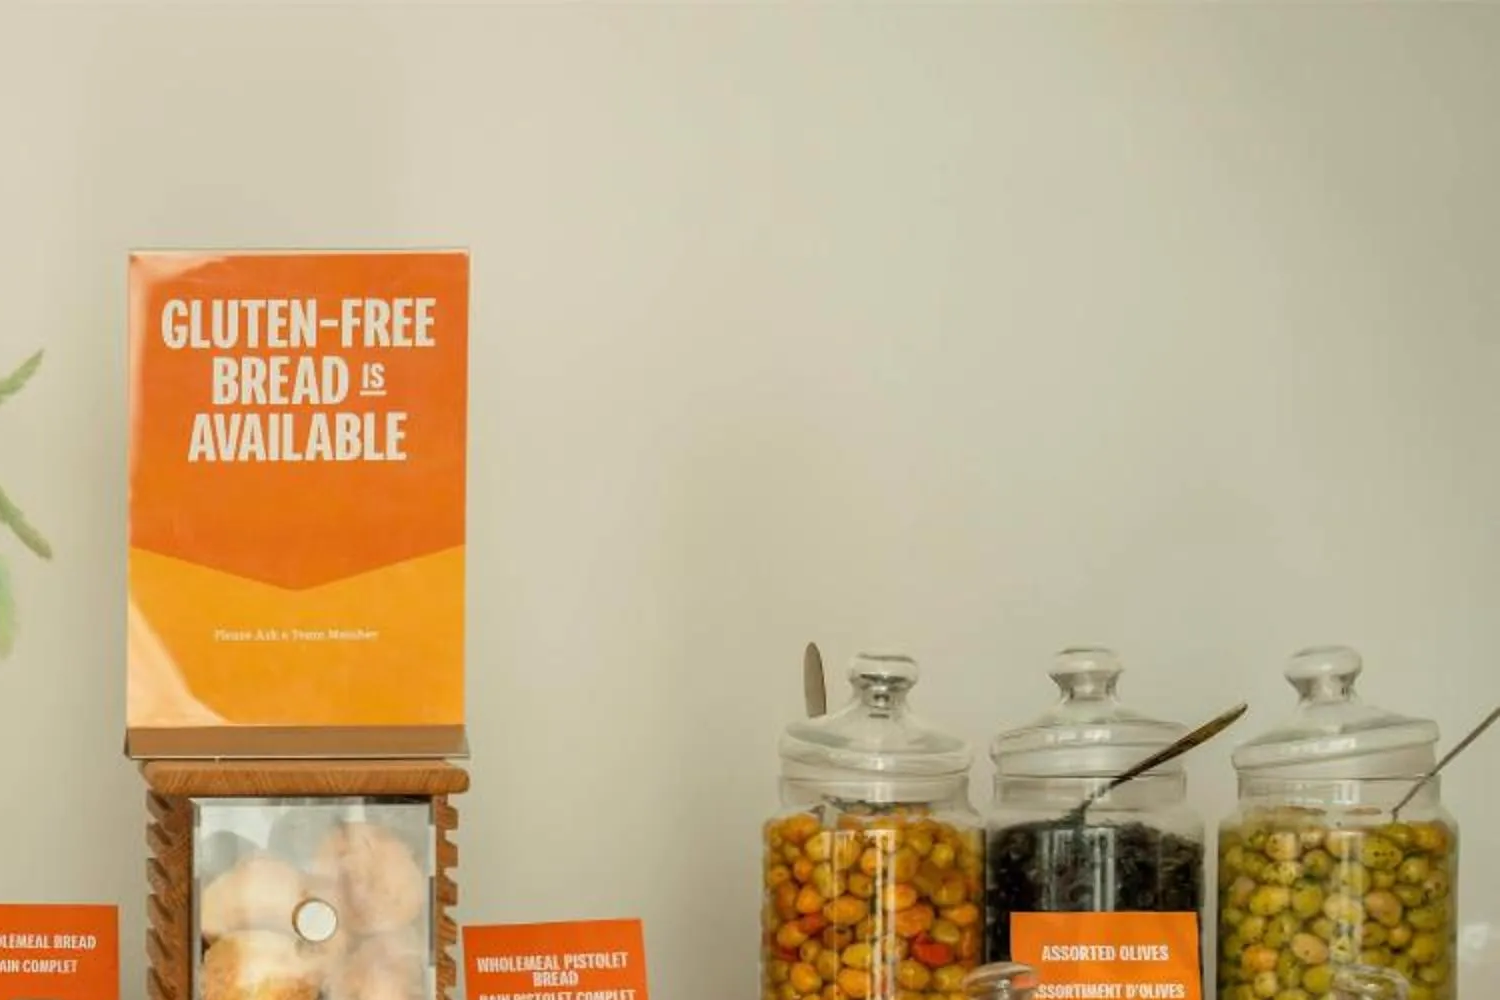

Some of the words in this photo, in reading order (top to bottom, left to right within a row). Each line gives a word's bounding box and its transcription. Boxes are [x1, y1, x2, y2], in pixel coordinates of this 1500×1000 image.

[161, 297, 437, 349] GLUTEN-FREE
[212, 355, 349, 405] BREAD
[361, 363, 386, 389] IS
[188, 412, 408, 462] AVAILABLE
[213, 628, 251, 641] Please
[255, 629, 277, 641] Ask
[292, 629, 325, 641] Team
[328, 628, 378, 640] Member
[53, 934, 97, 950] BREAD
[1041, 945, 1116, 961] ASSORTED
[1119, 945, 1170, 961] OLIVES
[22, 959, 77, 973] COMPLET
[476, 954, 561, 973] WHOLEMEAL
[563, 951, 629, 970] PISTOLET
[532, 970, 579, 987] BREAD
[1125, 983, 1185, 999] D'OLIVES
